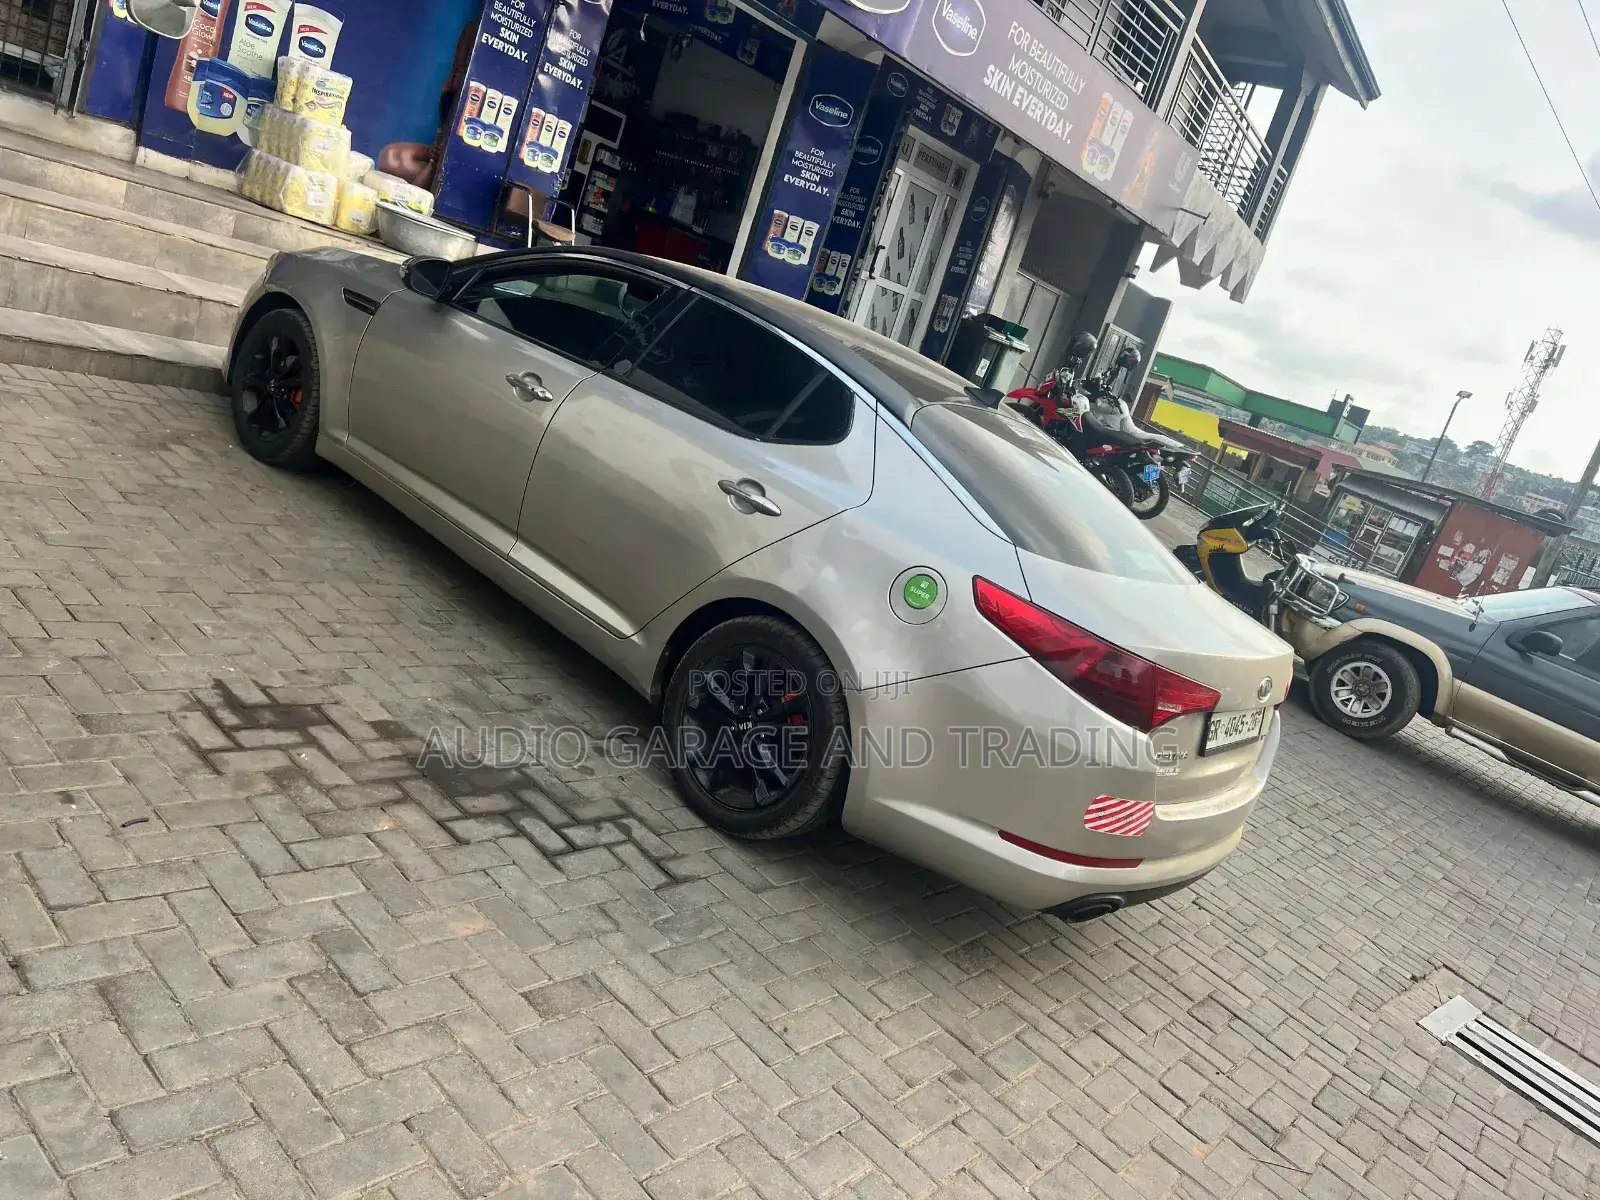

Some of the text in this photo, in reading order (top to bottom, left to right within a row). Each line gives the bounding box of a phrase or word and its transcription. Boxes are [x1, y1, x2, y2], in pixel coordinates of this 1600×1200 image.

[510, 0, 526, 11] FOR
[651, 1, 689, 15] EVERYDAY.
[493, 0, 537, 28] BEAUTIFULLY
[193, 19, 216, 33] Coco
[247, 17, 272, 33] Vaseline
[490, 11, 534, 38] MOISTURIZED
[191, 27, 215, 41] Glow
[499, 26, 520, 45] SKIN
[569, 29, 582, 40] FOR
[238, 38, 256, 49] Aloe
[301, 39, 324, 54] Vaseline
[481, 32, 529, 63] EVERYDAY.
[555, 32, 591, 57] BEAUTIFULLY
[237, 44, 263, 61] Soothe
[1007, 21, 1087, 96] FOR BEAUTIFULLY
[558, 57, 577, 73] SKIN
[543, 62, 583, 91] EVERYDAY.
[1008, 53, 1069, 111] MOISTURIZED
[815, 100, 849, 119] Vaseline
[983, 64, 1073, 145] SKIN EVERYDAY.
[794, 150, 836, 170] BEAUTIFULLY
[810, 147, 825, 158] FOR
[791, 158, 834, 178] MOISTURIZED
[800, 169, 821, 183] SKIN
[783, 174, 830, 197] EVERYDAY.
[849, 186, 860, 195] FOR
[840, 192, 868, 204] EAUTIFULLY
[841, 208, 856, 218] SKIN
[832, 215, 861, 229] VERYDAY.
[909, 585, 930, 600] SUPER
[738, 721, 753, 731] KIA
